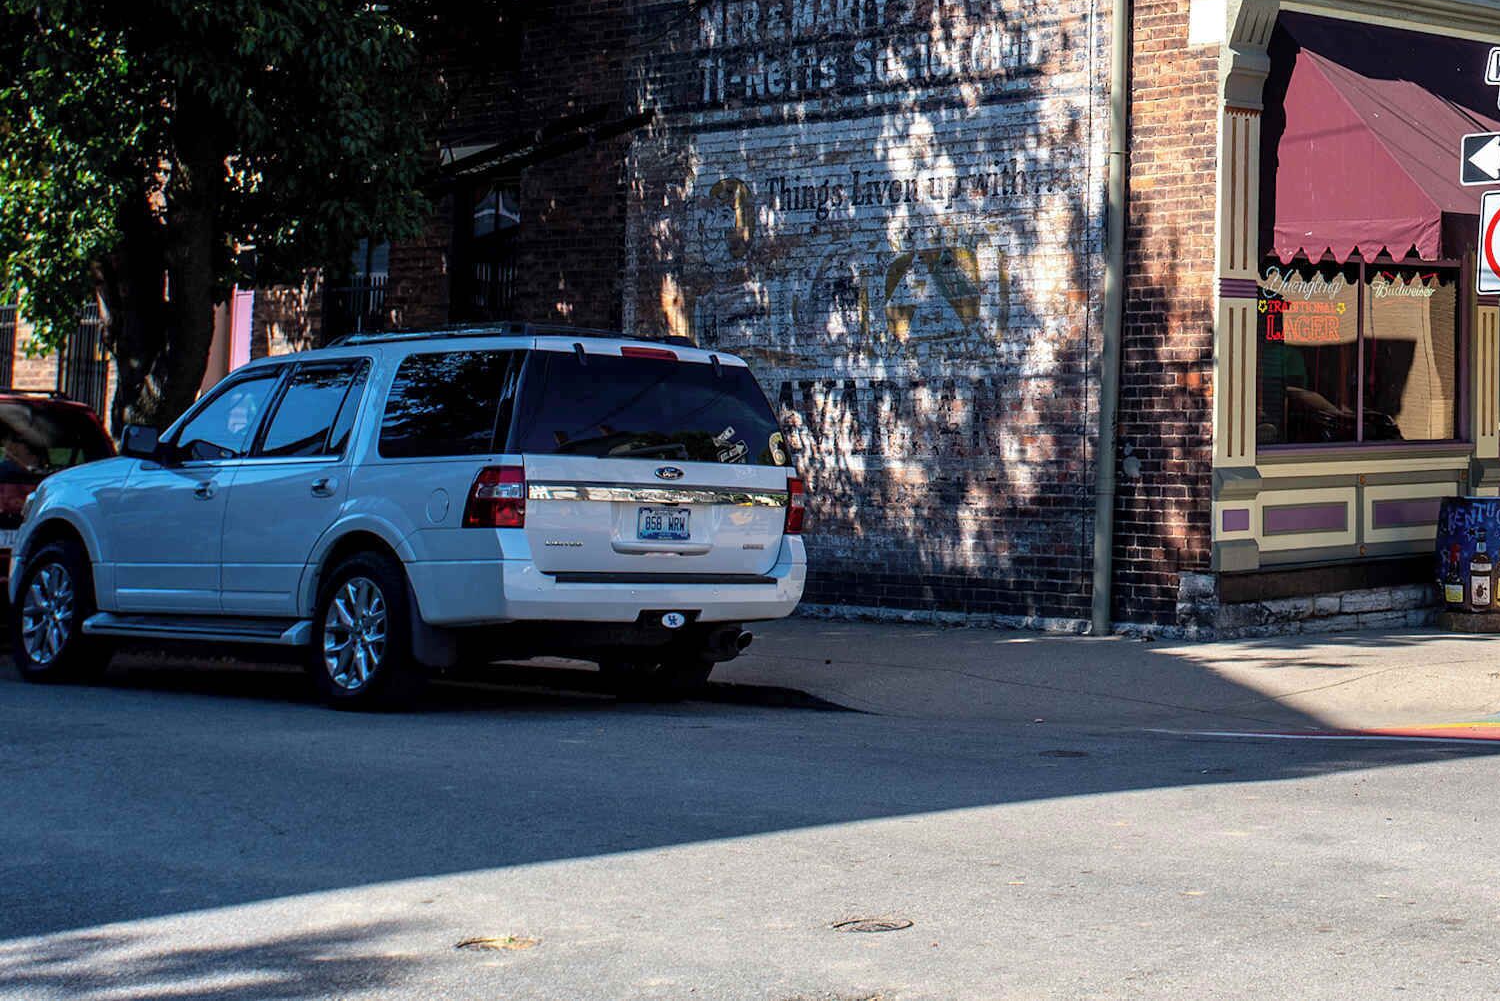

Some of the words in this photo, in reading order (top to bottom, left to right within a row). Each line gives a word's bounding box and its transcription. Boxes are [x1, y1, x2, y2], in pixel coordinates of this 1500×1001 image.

[1262, 265, 1345, 300] Yuengling
[1371, 280, 1436, 298] Budweiser
[1267, 300, 1337, 314] TRADITIONAL
[1266, 315, 1340, 341] LAGER
